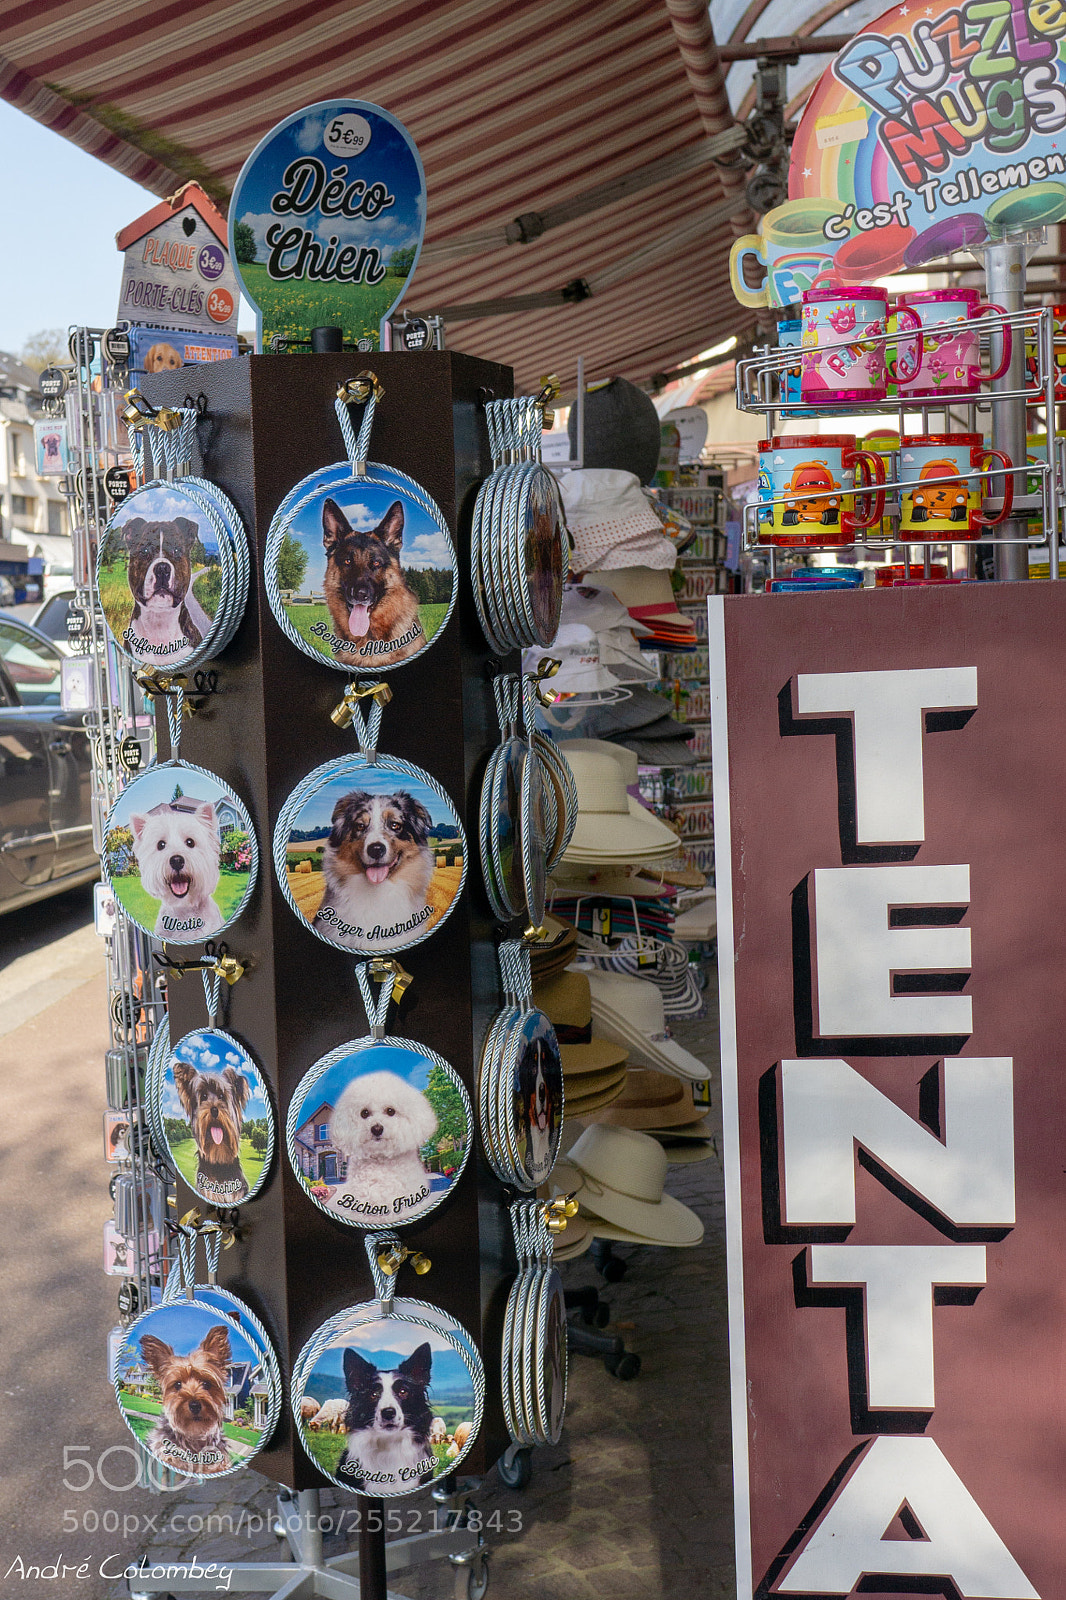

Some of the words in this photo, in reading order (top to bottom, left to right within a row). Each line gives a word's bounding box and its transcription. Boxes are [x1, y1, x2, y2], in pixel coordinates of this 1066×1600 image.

[329, 121, 364, 146] 5€99
[880, 63, 1066, 186] Mugs
[271, 157, 394, 219] Déco
[823, 191, 912, 240] c'est
[915, 153, 1066, 212] Tellemen
[143, 238, 196, 271] PLAQUE
[266, 223, 386, 284] Chien
[125, 279, 205, 315] PORTE-CLÉS
[406, 331, 425, 341] PORTE
[41, 380, 61, 388] PORTE
[108, 480, 127, 488] PORTE
[122, 627, 190, 655] Staffordshire
[309, 621, 357, 654] Berger
[359, 622, 422, 656] Allemand
[162, 915, 204, 931] Westie
[317, 906, 363, 938] Berger
[366, 904, 434, 940] Australien
[336, 1193, 390, 1215] Bichon
[392, 1184, 430, 1213] Frisé
[162, 1439, 224, 1464] Yorkshire
[340, 1460, 396, 1483] Border
[398, 1456, 439, 1482] Collie
